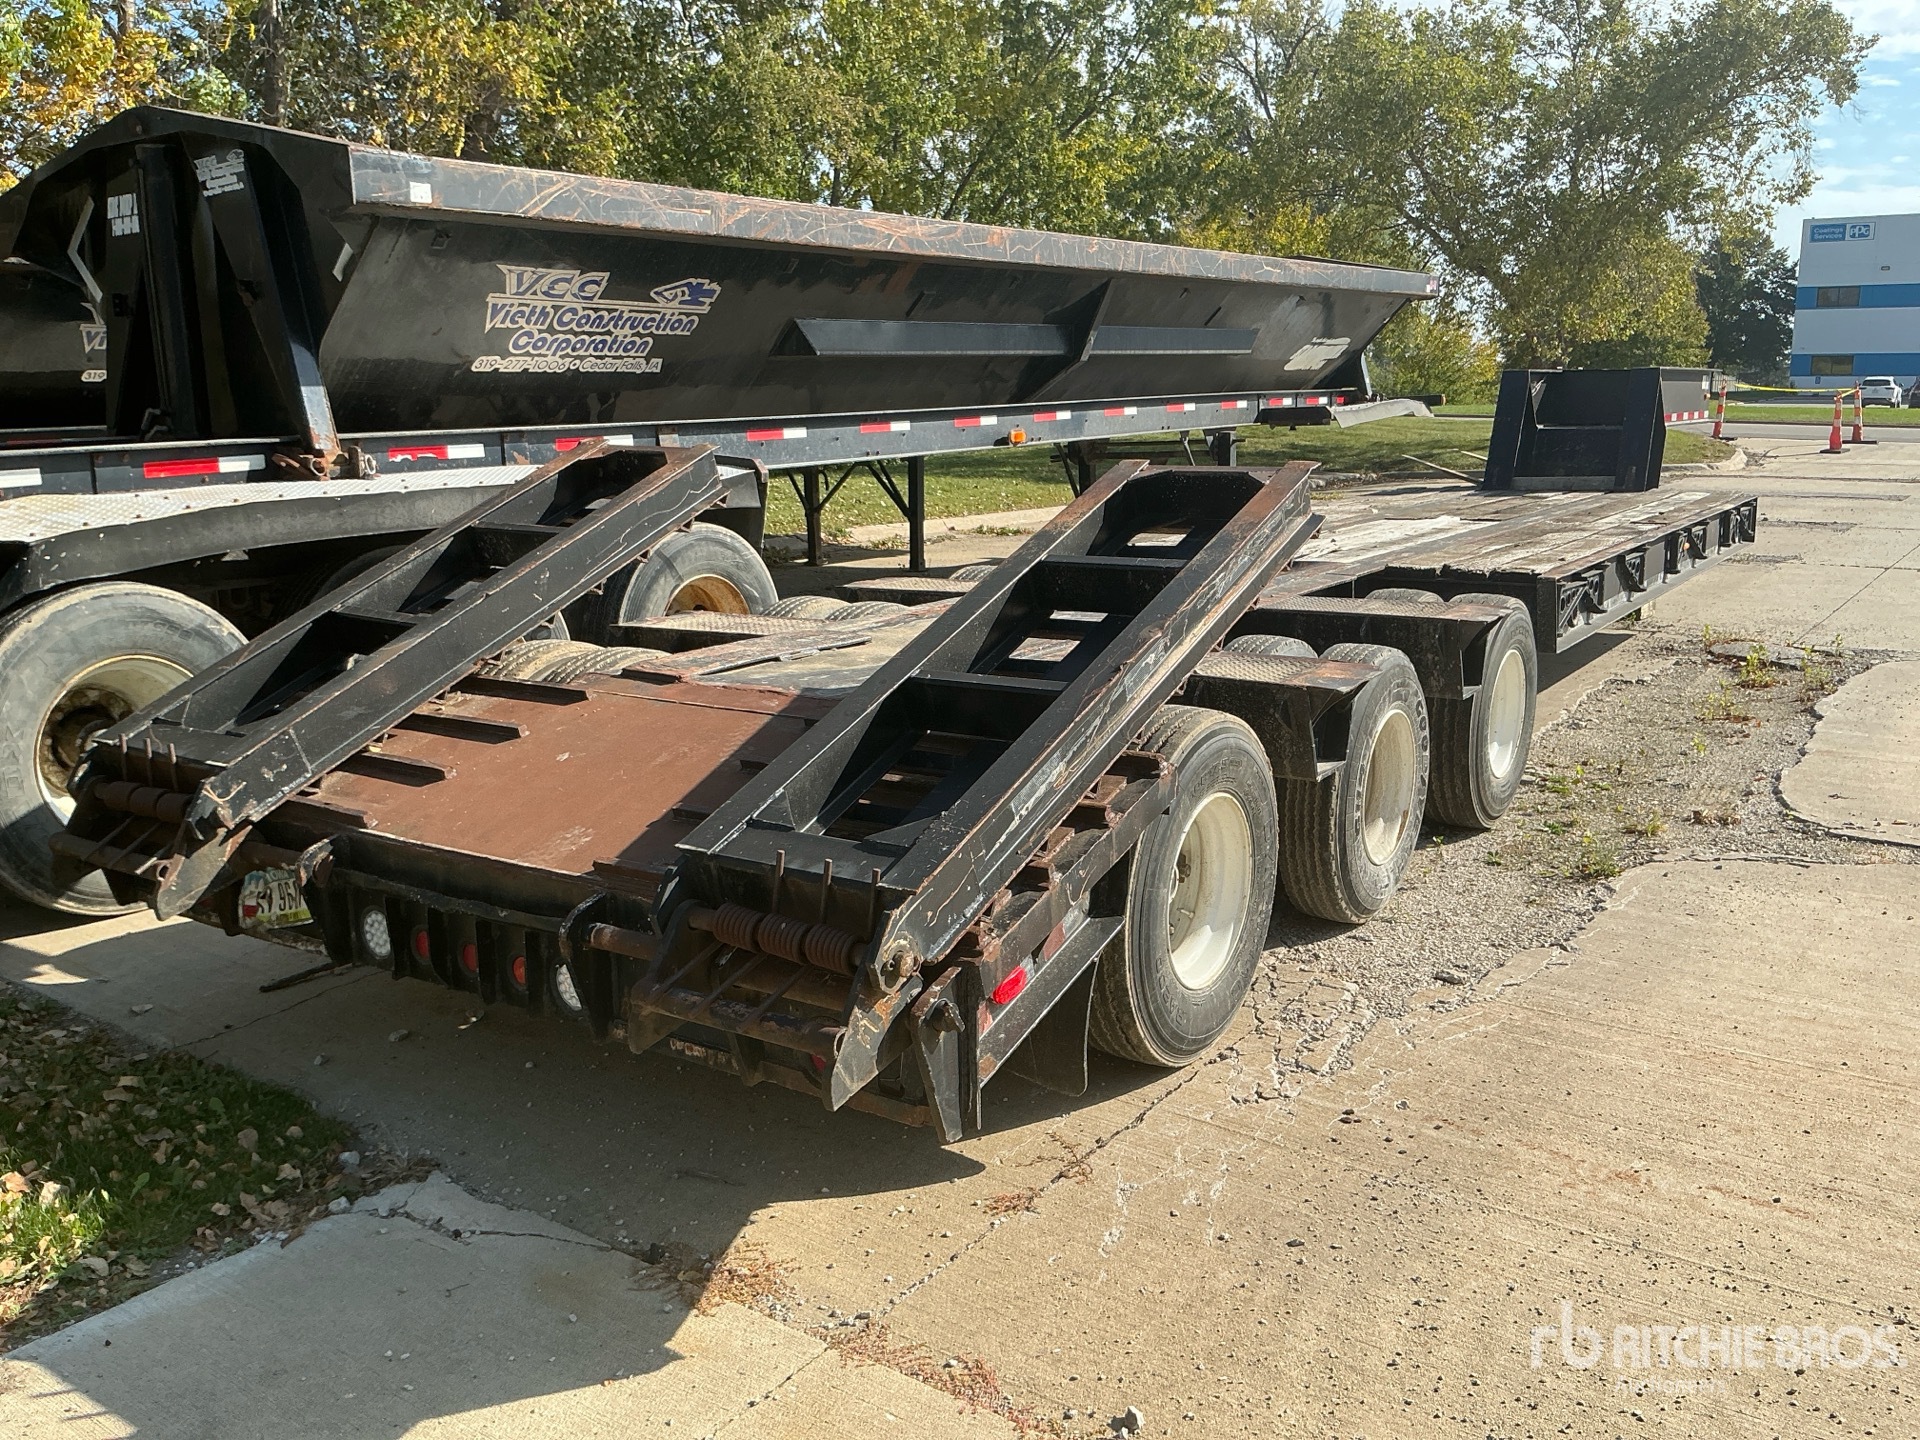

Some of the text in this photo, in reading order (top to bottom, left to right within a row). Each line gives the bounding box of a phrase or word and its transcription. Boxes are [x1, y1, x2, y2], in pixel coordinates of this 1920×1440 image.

[1850, 226, 1869, 238] PPG
[505, 268, 607, 300] VCC
[486, 303, 698, 333] Vieth Construction
[511, 332, 651, 357] Corporation
[580, 360, 618, 372] Cedar
